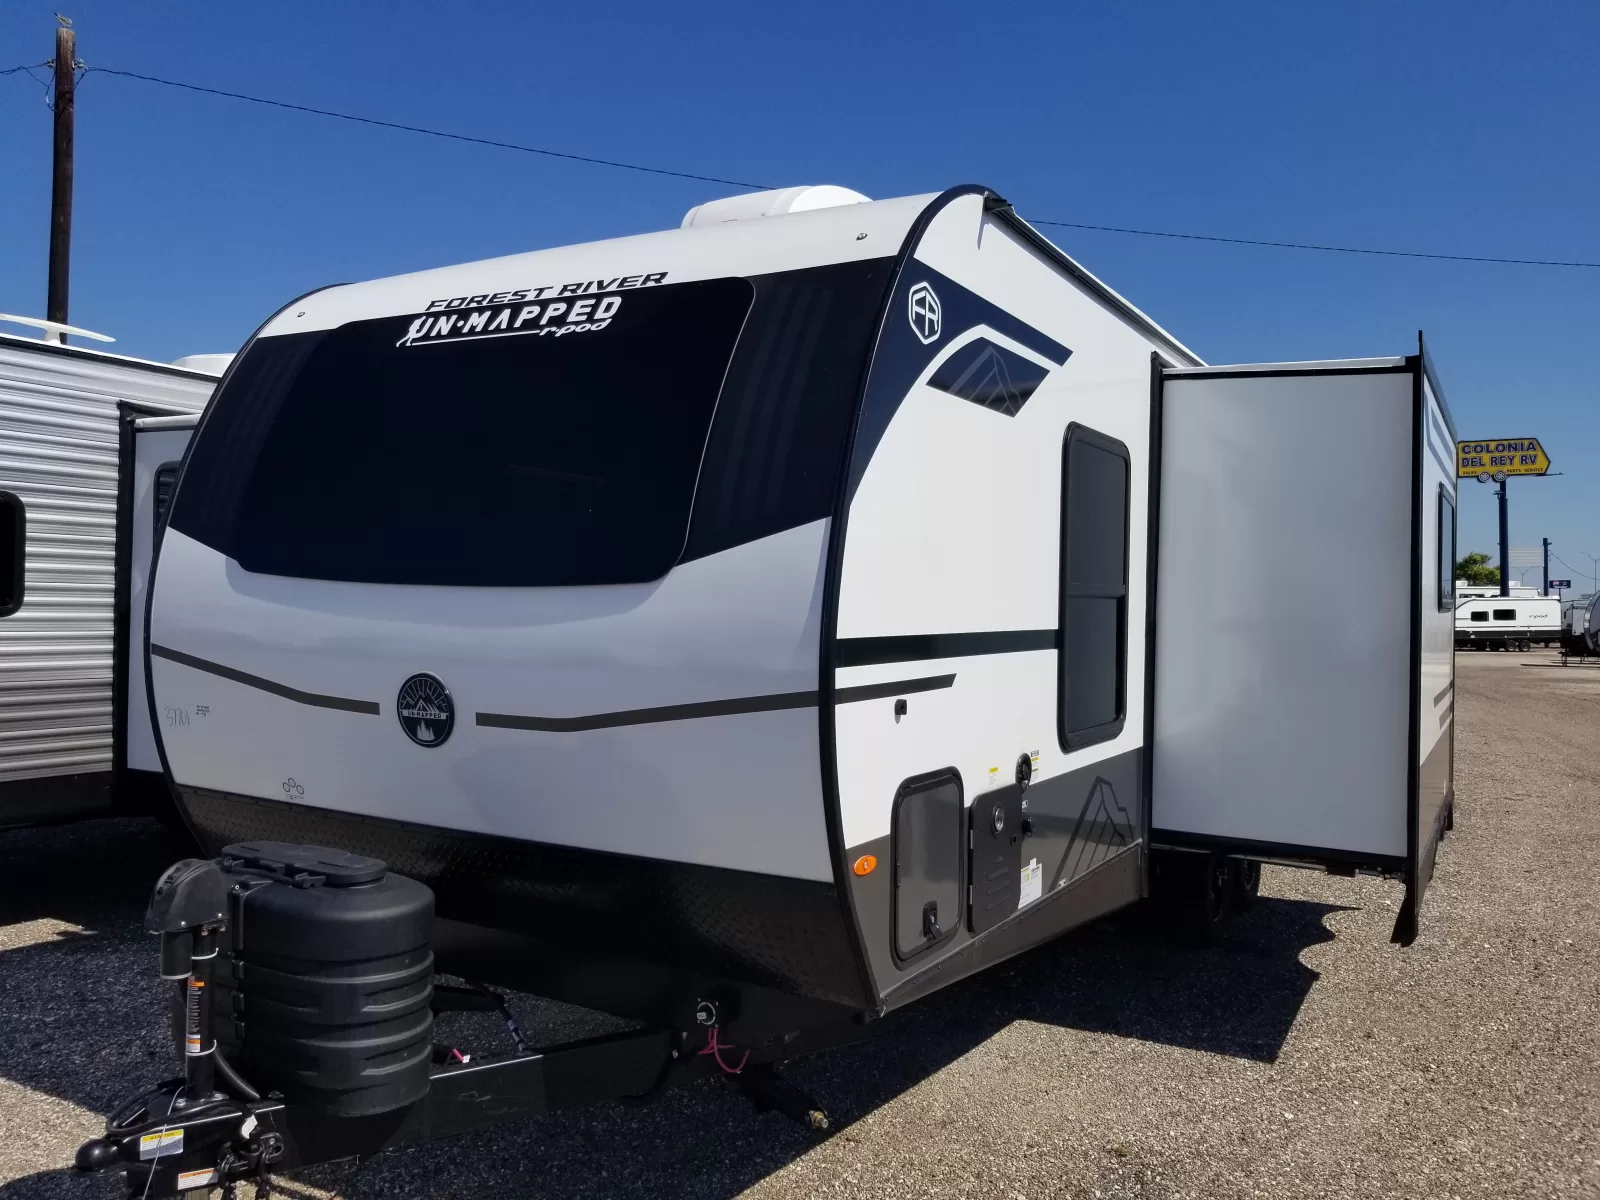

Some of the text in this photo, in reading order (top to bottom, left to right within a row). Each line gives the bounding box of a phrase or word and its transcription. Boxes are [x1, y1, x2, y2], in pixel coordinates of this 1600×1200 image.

[425, 272, 668, 311] FOREST RIVER
[1462, 441, 1537, 454] COLONIA
[1461, 454, 1537, 468] DEL REY RV
